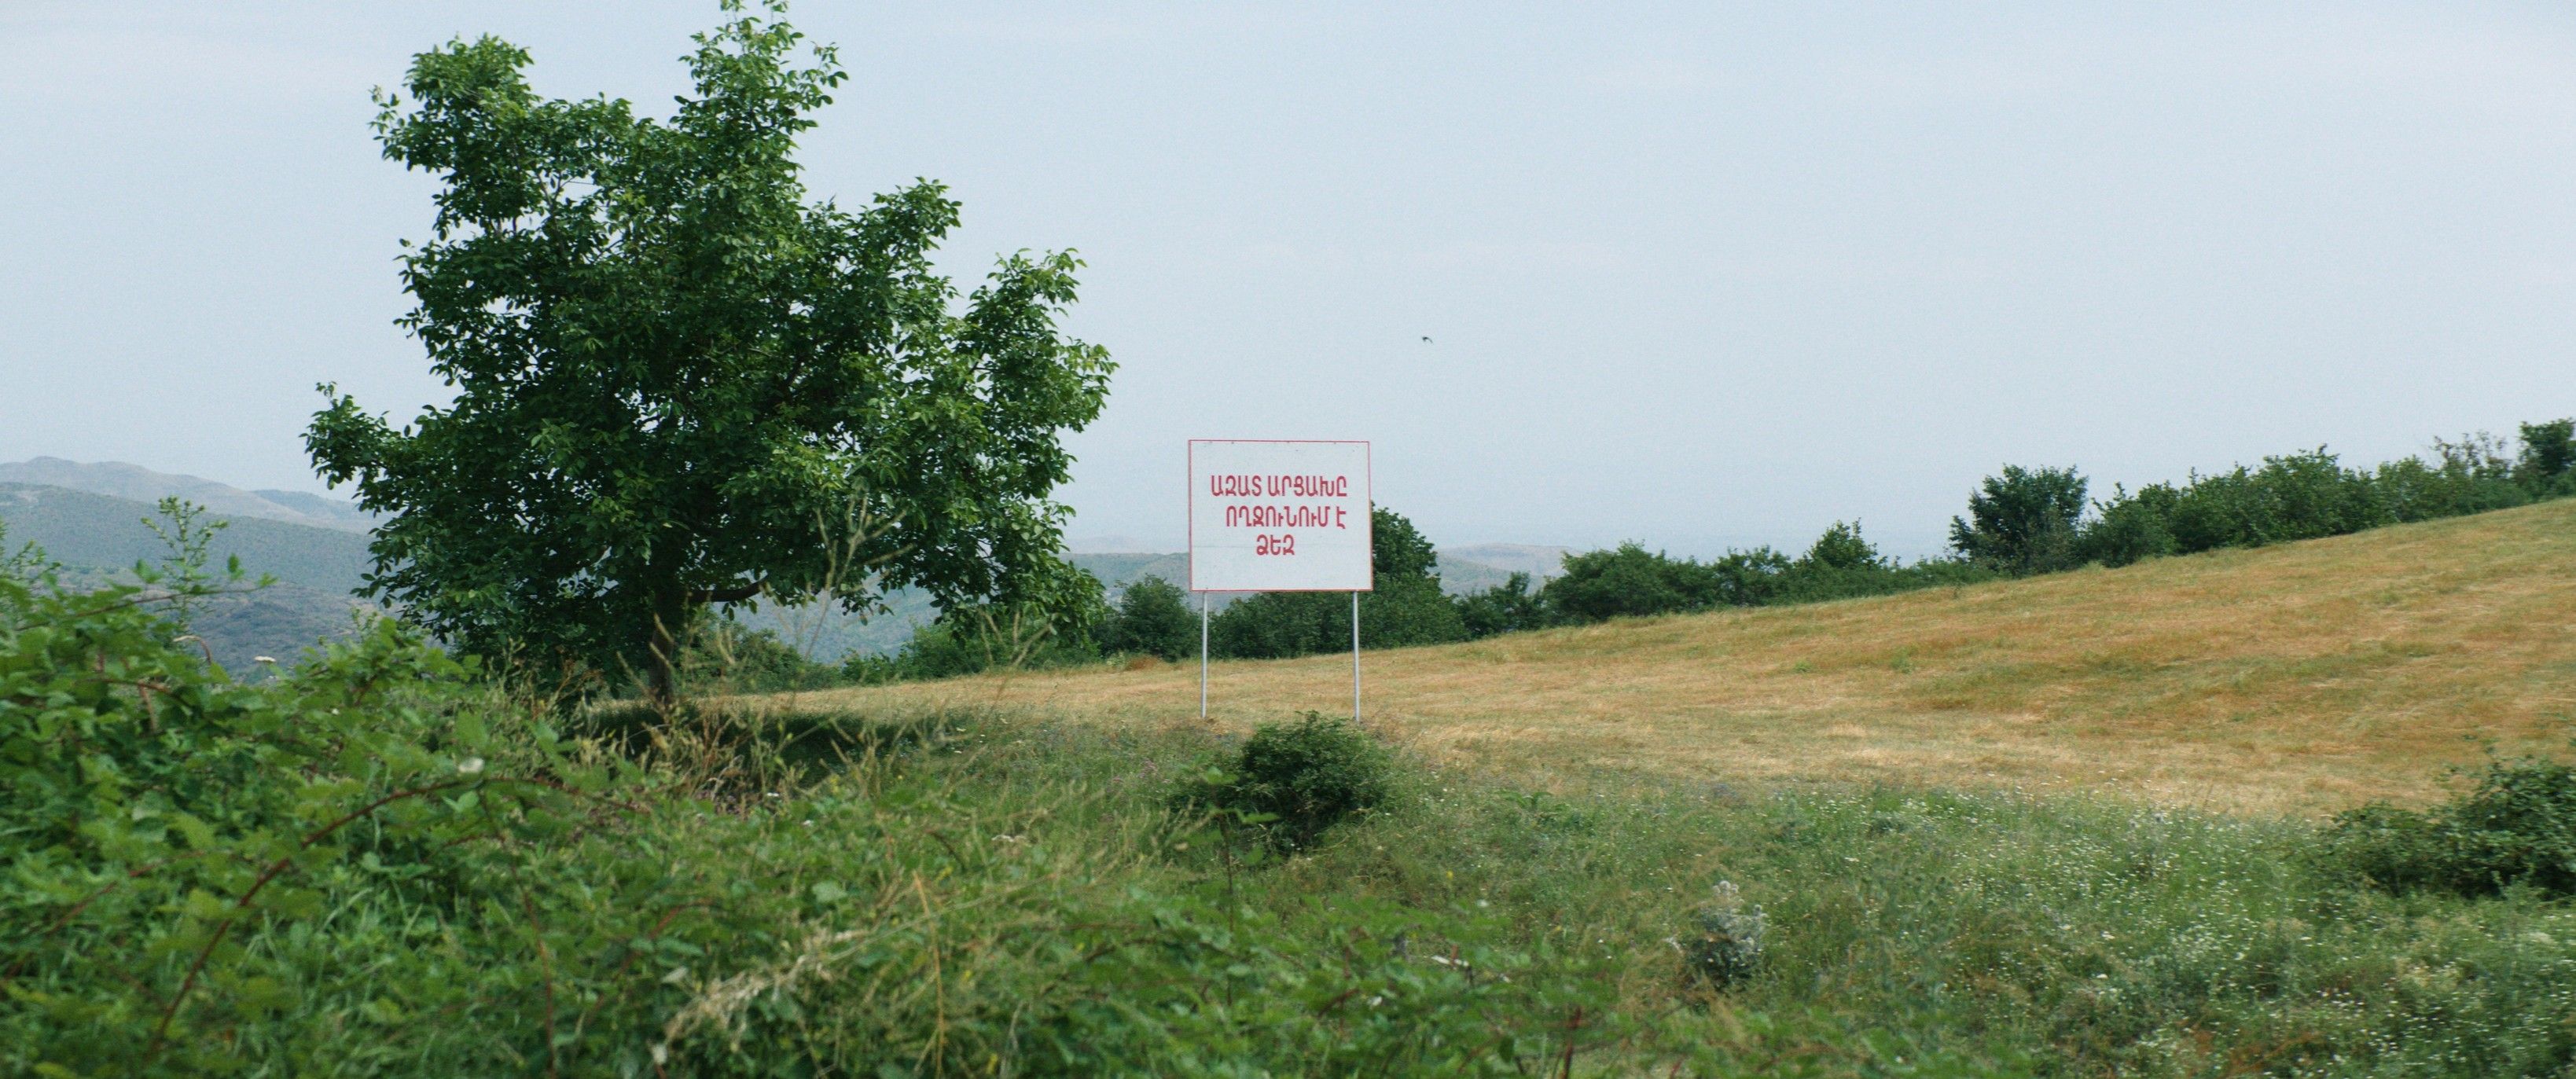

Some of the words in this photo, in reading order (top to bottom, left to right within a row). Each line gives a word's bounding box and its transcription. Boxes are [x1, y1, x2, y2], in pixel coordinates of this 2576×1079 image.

[1211, 475, 1262, 497] ԱԶԱՏ
[1267, 475, 1347, 497] ԱՐՑԱԽԸ
[1336, 506, 1347, 529] Է
[1256, 534, 1295, 556] ՁԵԶ
